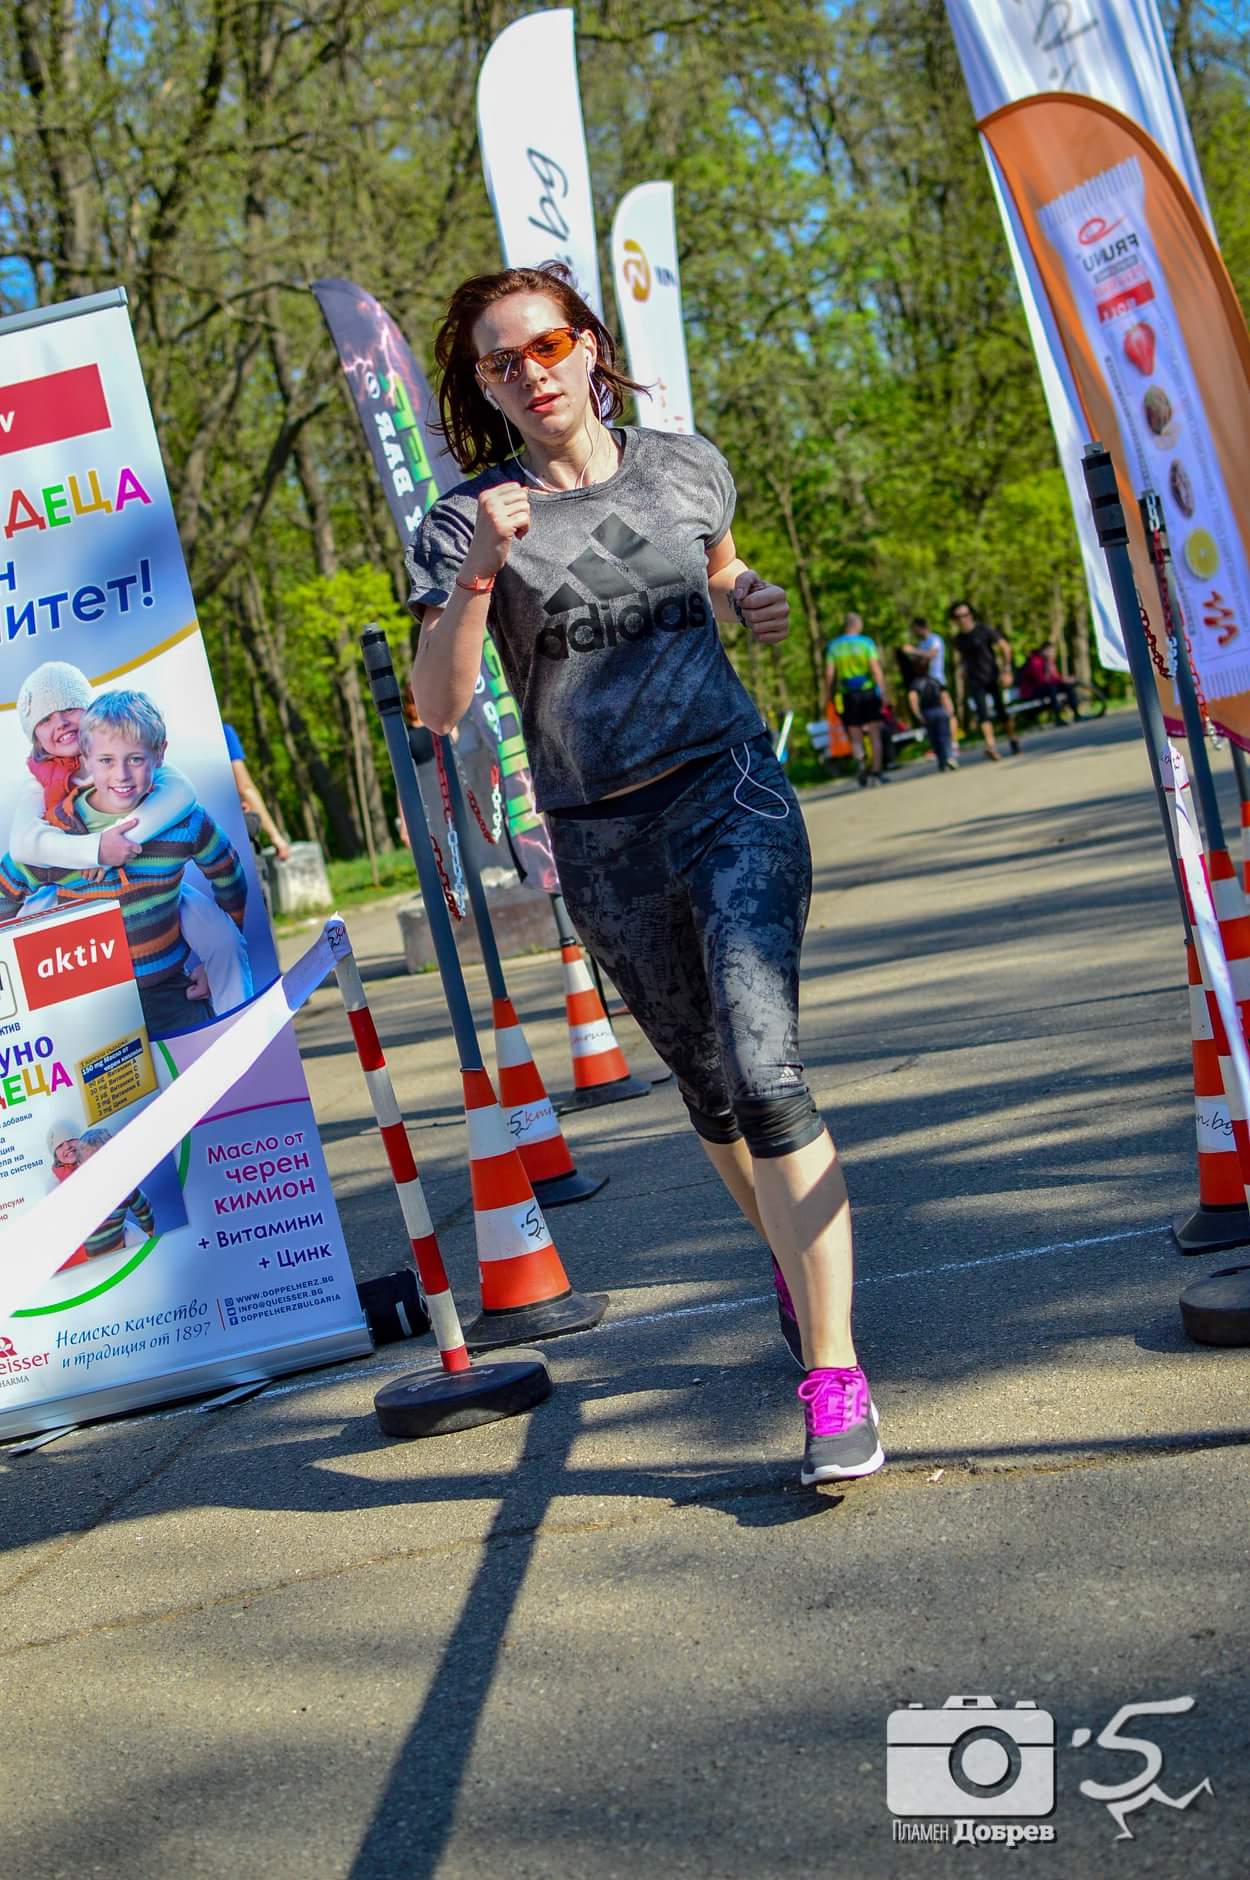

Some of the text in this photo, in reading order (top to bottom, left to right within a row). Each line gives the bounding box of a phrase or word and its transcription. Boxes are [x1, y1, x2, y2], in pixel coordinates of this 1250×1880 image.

[4, 467, 152, 540] ДЕЦА
[0, 558, 154, 641] итет!
[537, 590, 706, 660] adidas
[37, 938, 116, 979] aktiv
[10, 1158, 44, 1175] система
[207, 1132, 304, 1165] Масло от
[225, 1152, 310, 1184] черен
[214, 1177, 316, 1215] кимион
[198, 1211, 324, 1249] + Витамини
[258, 1243, 333, 1269] + Цинк
[235, 1275, 335, 1304] WWW.DOPPELHERZ.BG
[238, 1288, 324, 1313] INFO@QUEISSER.BG
[240, 1293, 342, 1323] DOPPELHERZBULGARIA
[56, 1299, 209, 1349] Немско качество
[62, 1321, 212, 1370] и традиция от 1897
